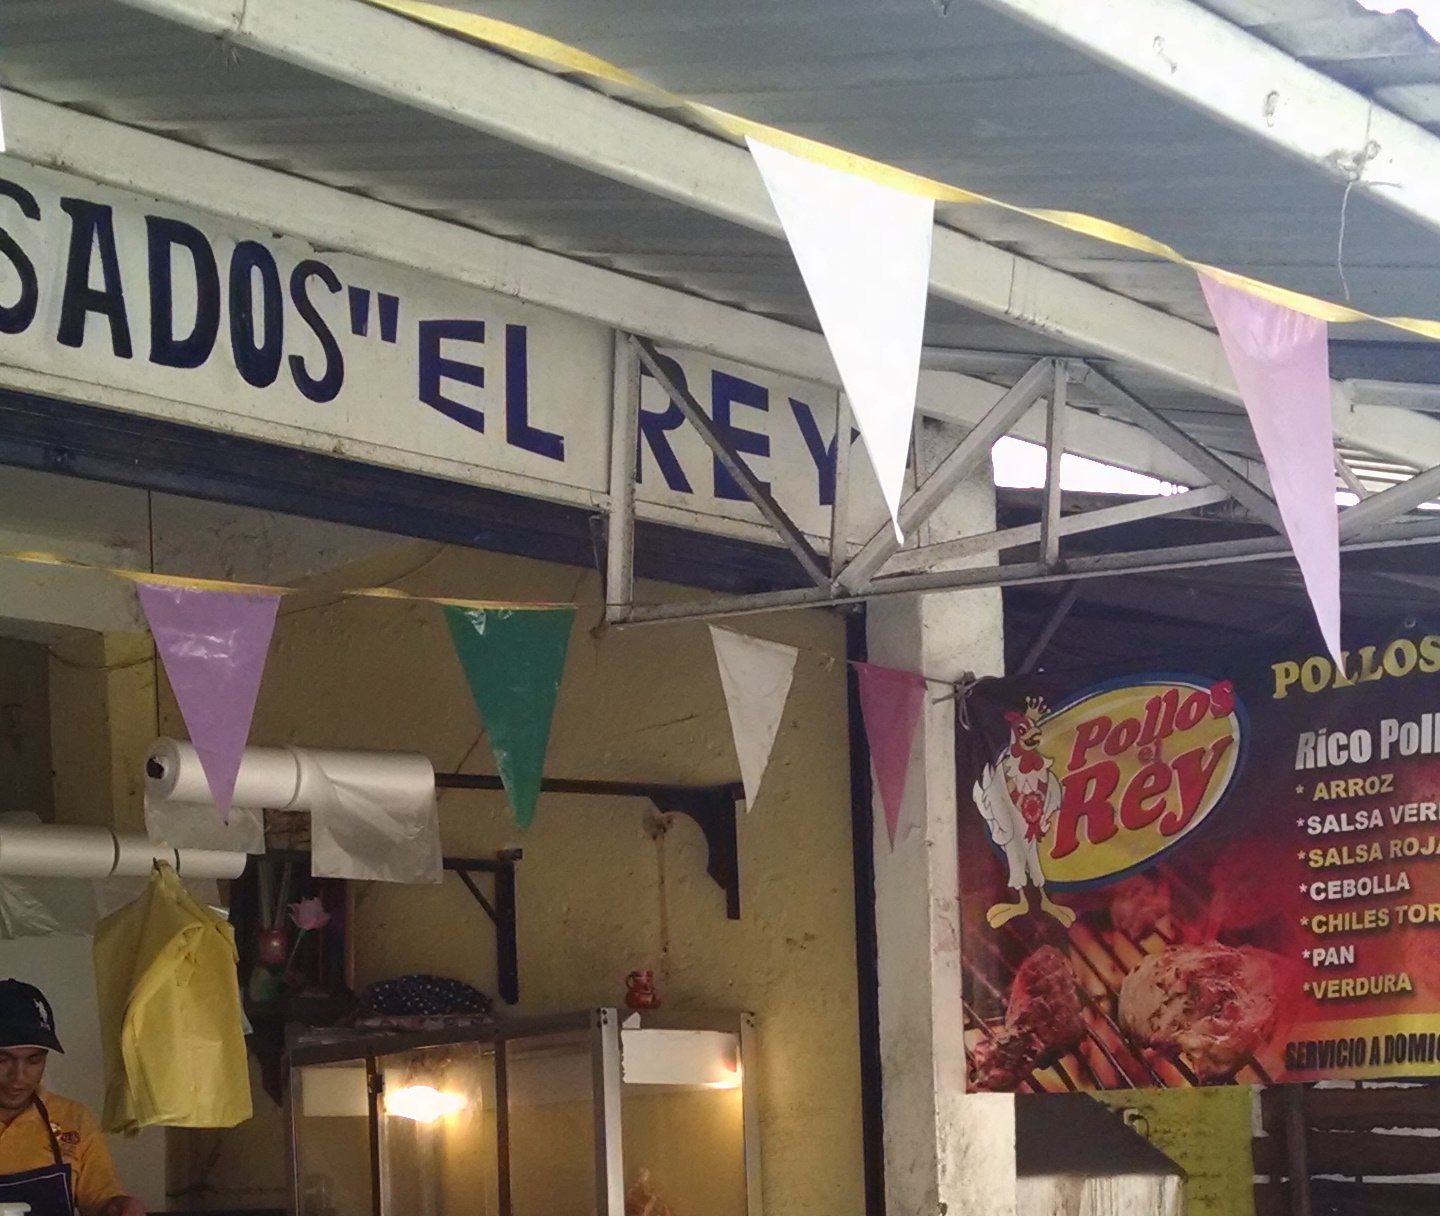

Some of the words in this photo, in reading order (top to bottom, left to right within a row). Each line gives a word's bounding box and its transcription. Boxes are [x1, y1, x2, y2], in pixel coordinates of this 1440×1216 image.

[1295, 728, 1373, 771] Rico
[1049, 735, 1235, 860] Rey
[1312, 773, 1394, 801] ARROZ
[1284, 1036, 1366, 1071] SERVICIO
[1369, 1037, 1379, 1067] A
